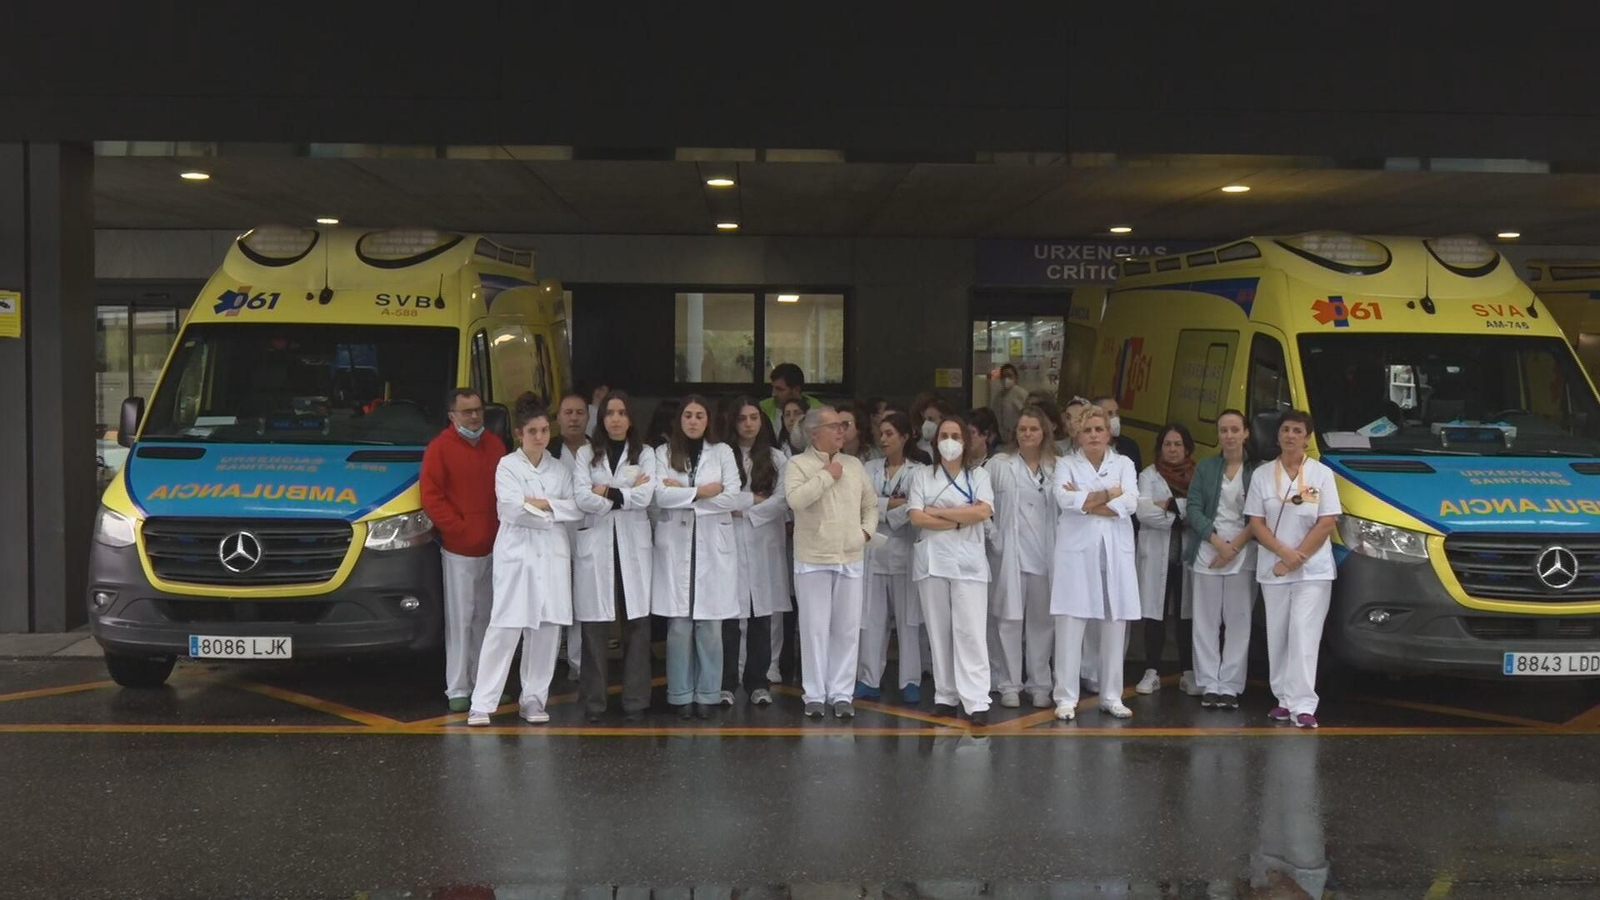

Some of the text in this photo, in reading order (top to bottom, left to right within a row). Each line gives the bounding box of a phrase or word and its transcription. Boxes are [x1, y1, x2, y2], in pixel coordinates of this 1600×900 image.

[1034, 245, 1168, 260] URXENCIAS
[230, 291, 281, 310] 061
[374, 293, 431, 309] SVB
[1471, 303, 1525, 318] SVA
[202, 639, 287, 655] 8086 LJK
[1517, 655, 1600, 672] 8843 LDD
